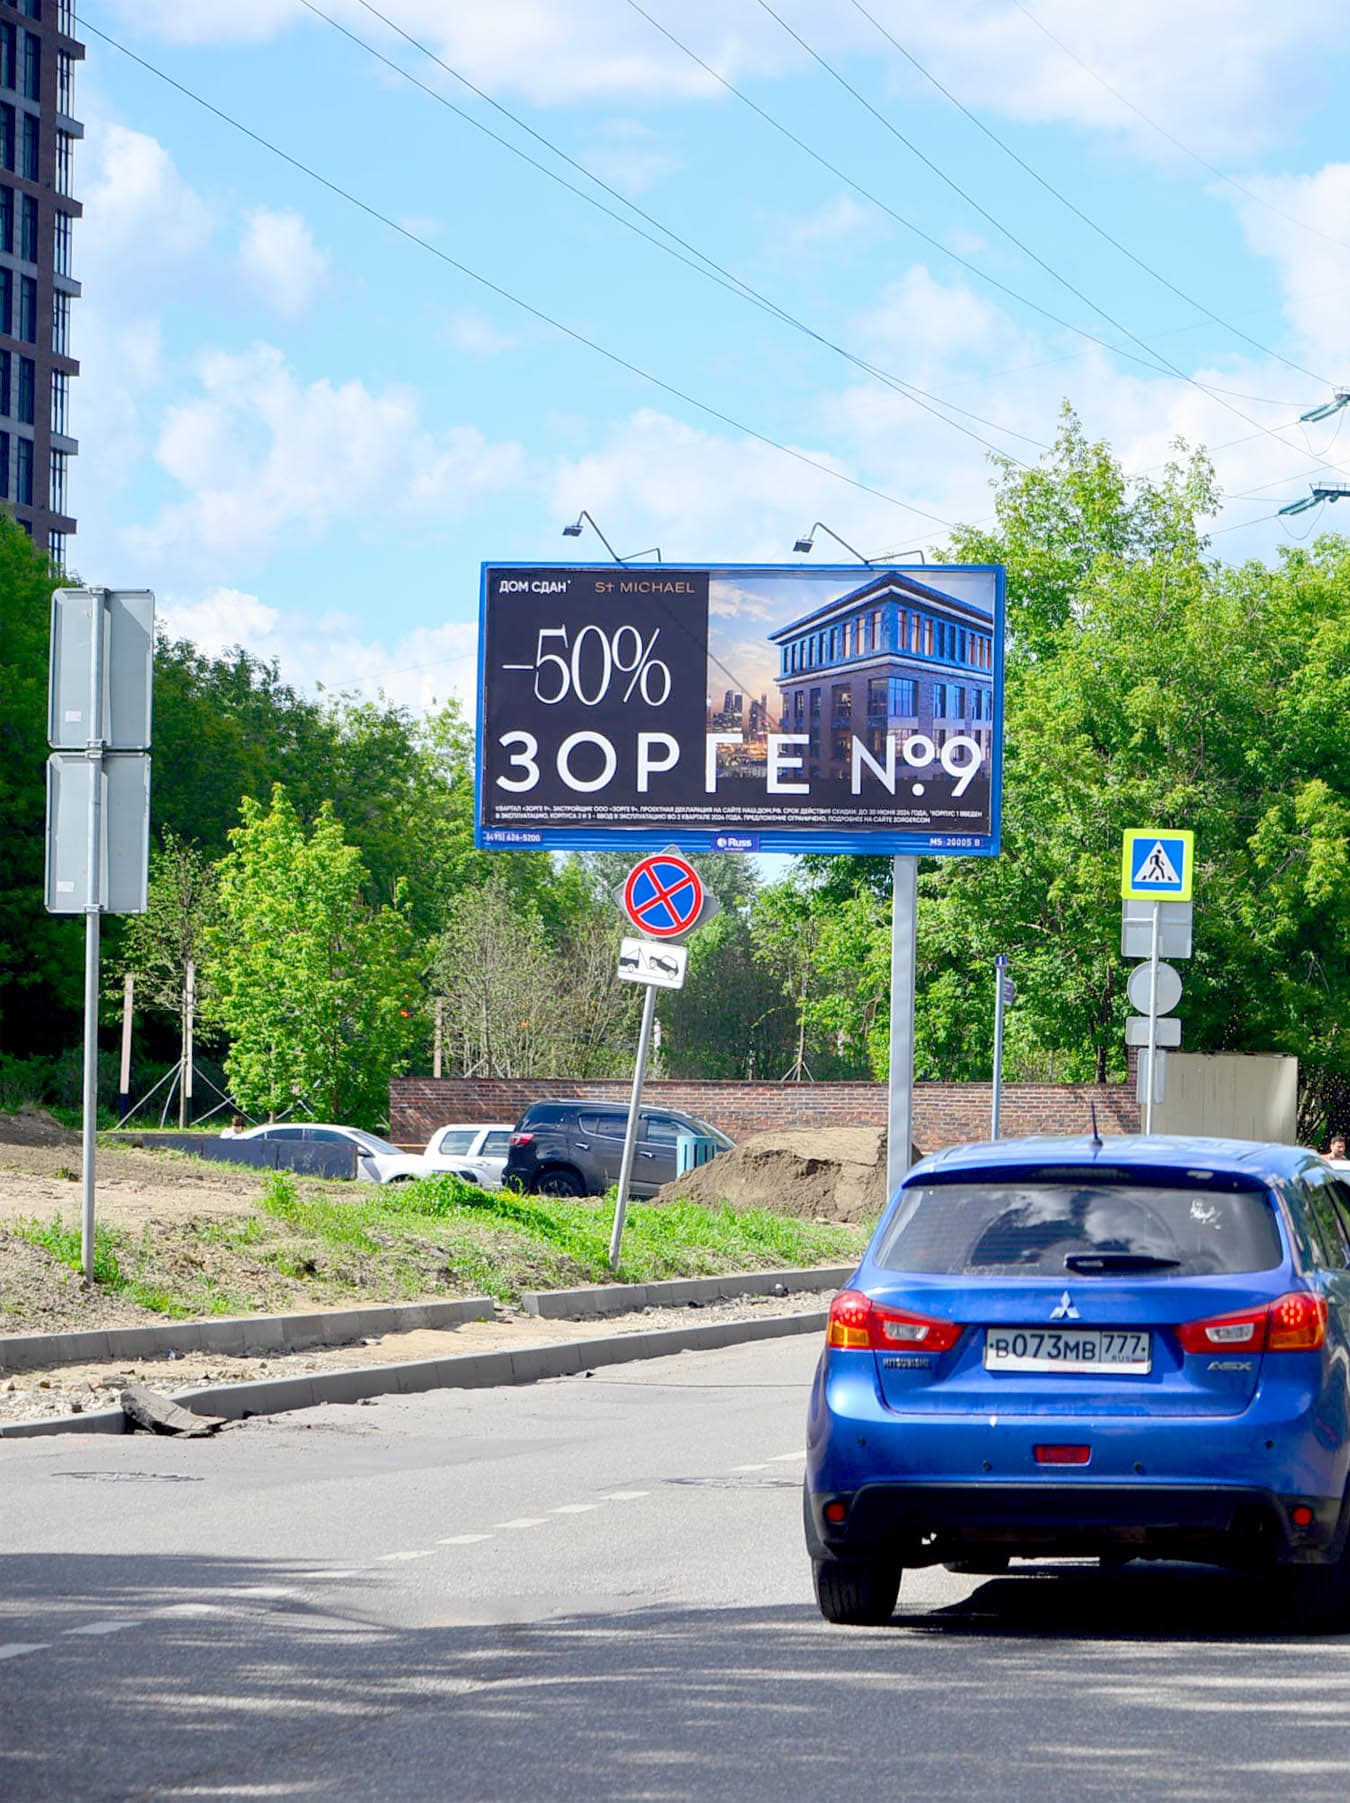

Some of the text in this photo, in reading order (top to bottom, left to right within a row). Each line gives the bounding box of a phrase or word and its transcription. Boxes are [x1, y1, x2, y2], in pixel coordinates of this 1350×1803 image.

[499, 580, 529, 594] ДОМ
[620, 582, 697, 594] MICHAEL
[495, 729, 811, 795] ЗОРГЕ
[594, 805, 608, 813] ООО
[873, 816, 894, 824] САЙТЕ
[727, 837, 753, 847] Russ
[996, 1334, 1141, 1361] В073МВ 777
